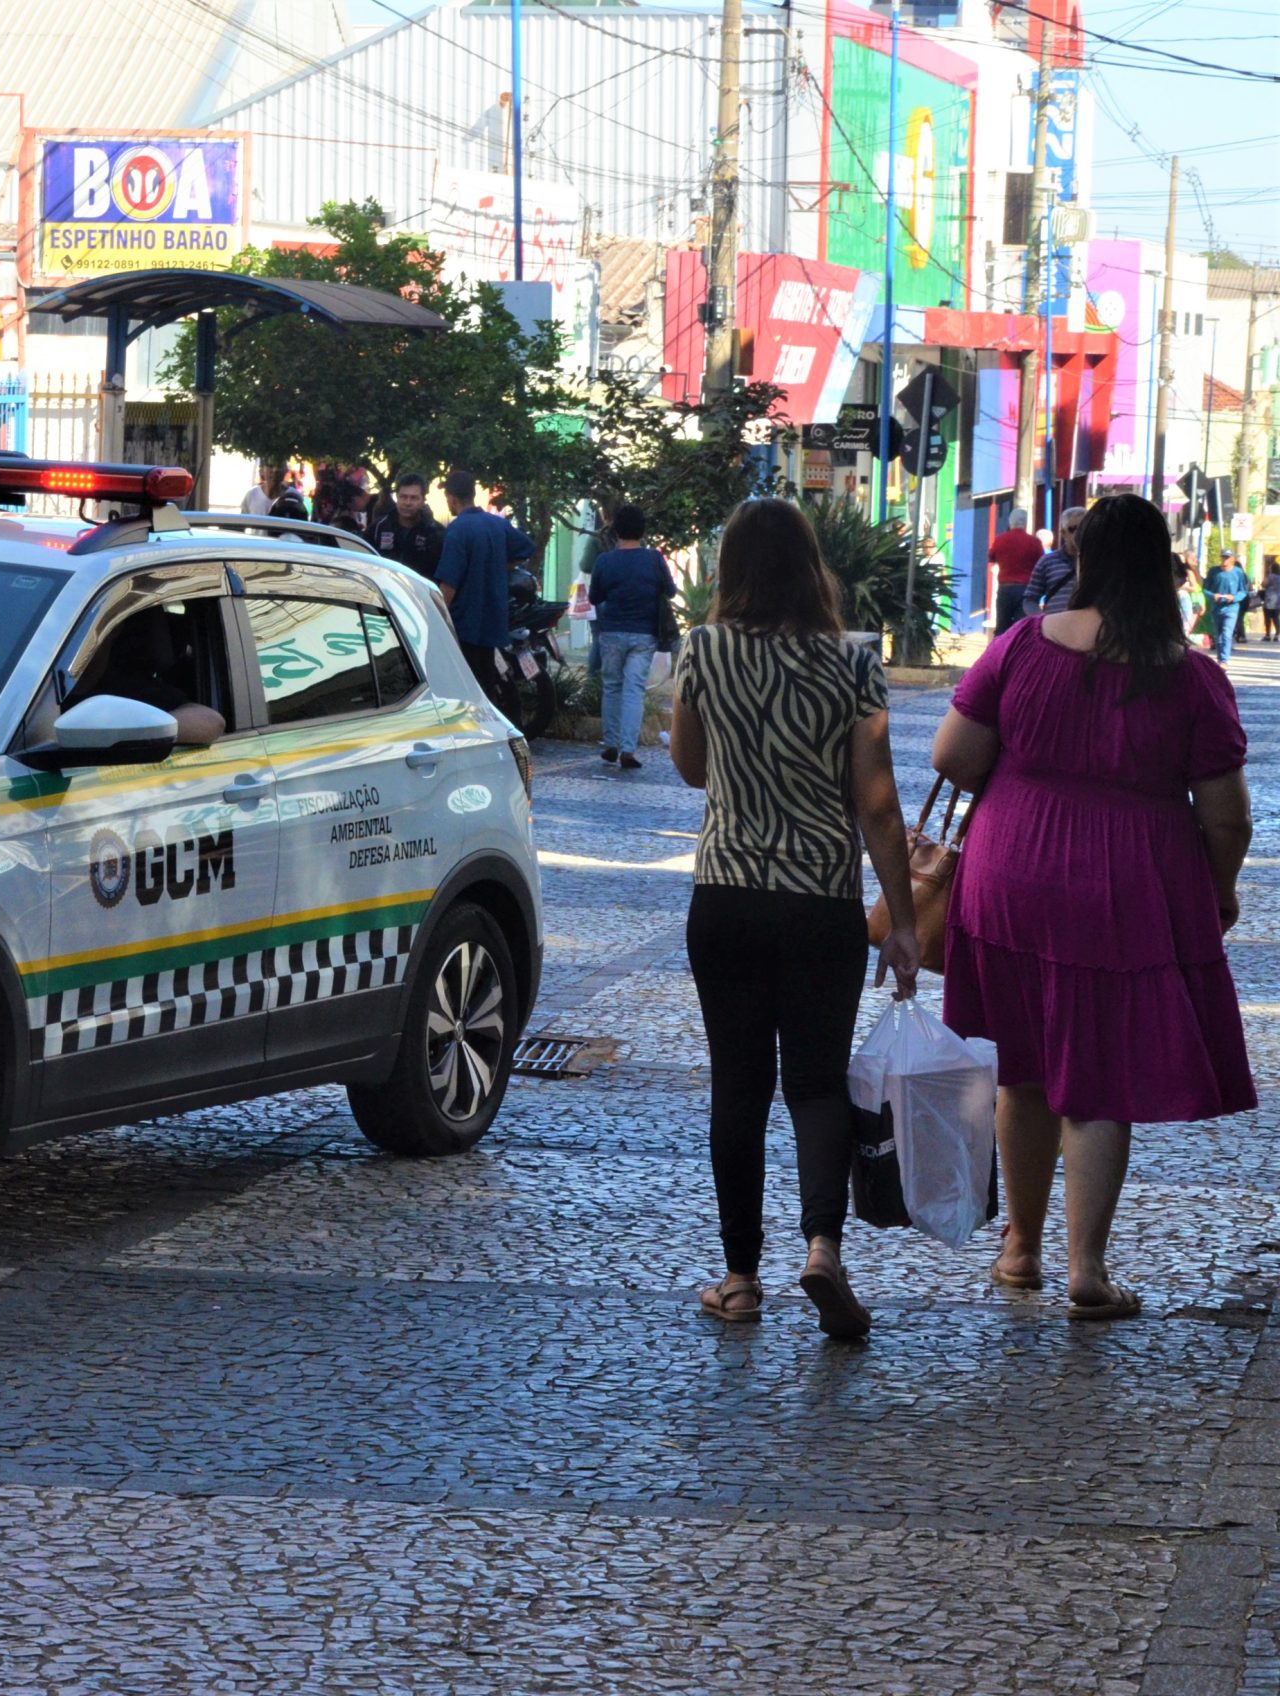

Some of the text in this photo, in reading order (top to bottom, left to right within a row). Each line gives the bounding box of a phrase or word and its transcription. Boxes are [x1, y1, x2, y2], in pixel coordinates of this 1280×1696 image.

[72, 144, 213, 221] BOA
[49, 226, 228, 251] ESPETINHO BARÃO
[76, 259, 140, 270] 99122-0891
[297, 783, 380, 817] FISCALIZAÇÃO
[330, 815, 393, 843] AMBIENTAL
[134, 817, 236, 906] GCM
[349, 837, 438, 869] DEFESA ANIMAL
